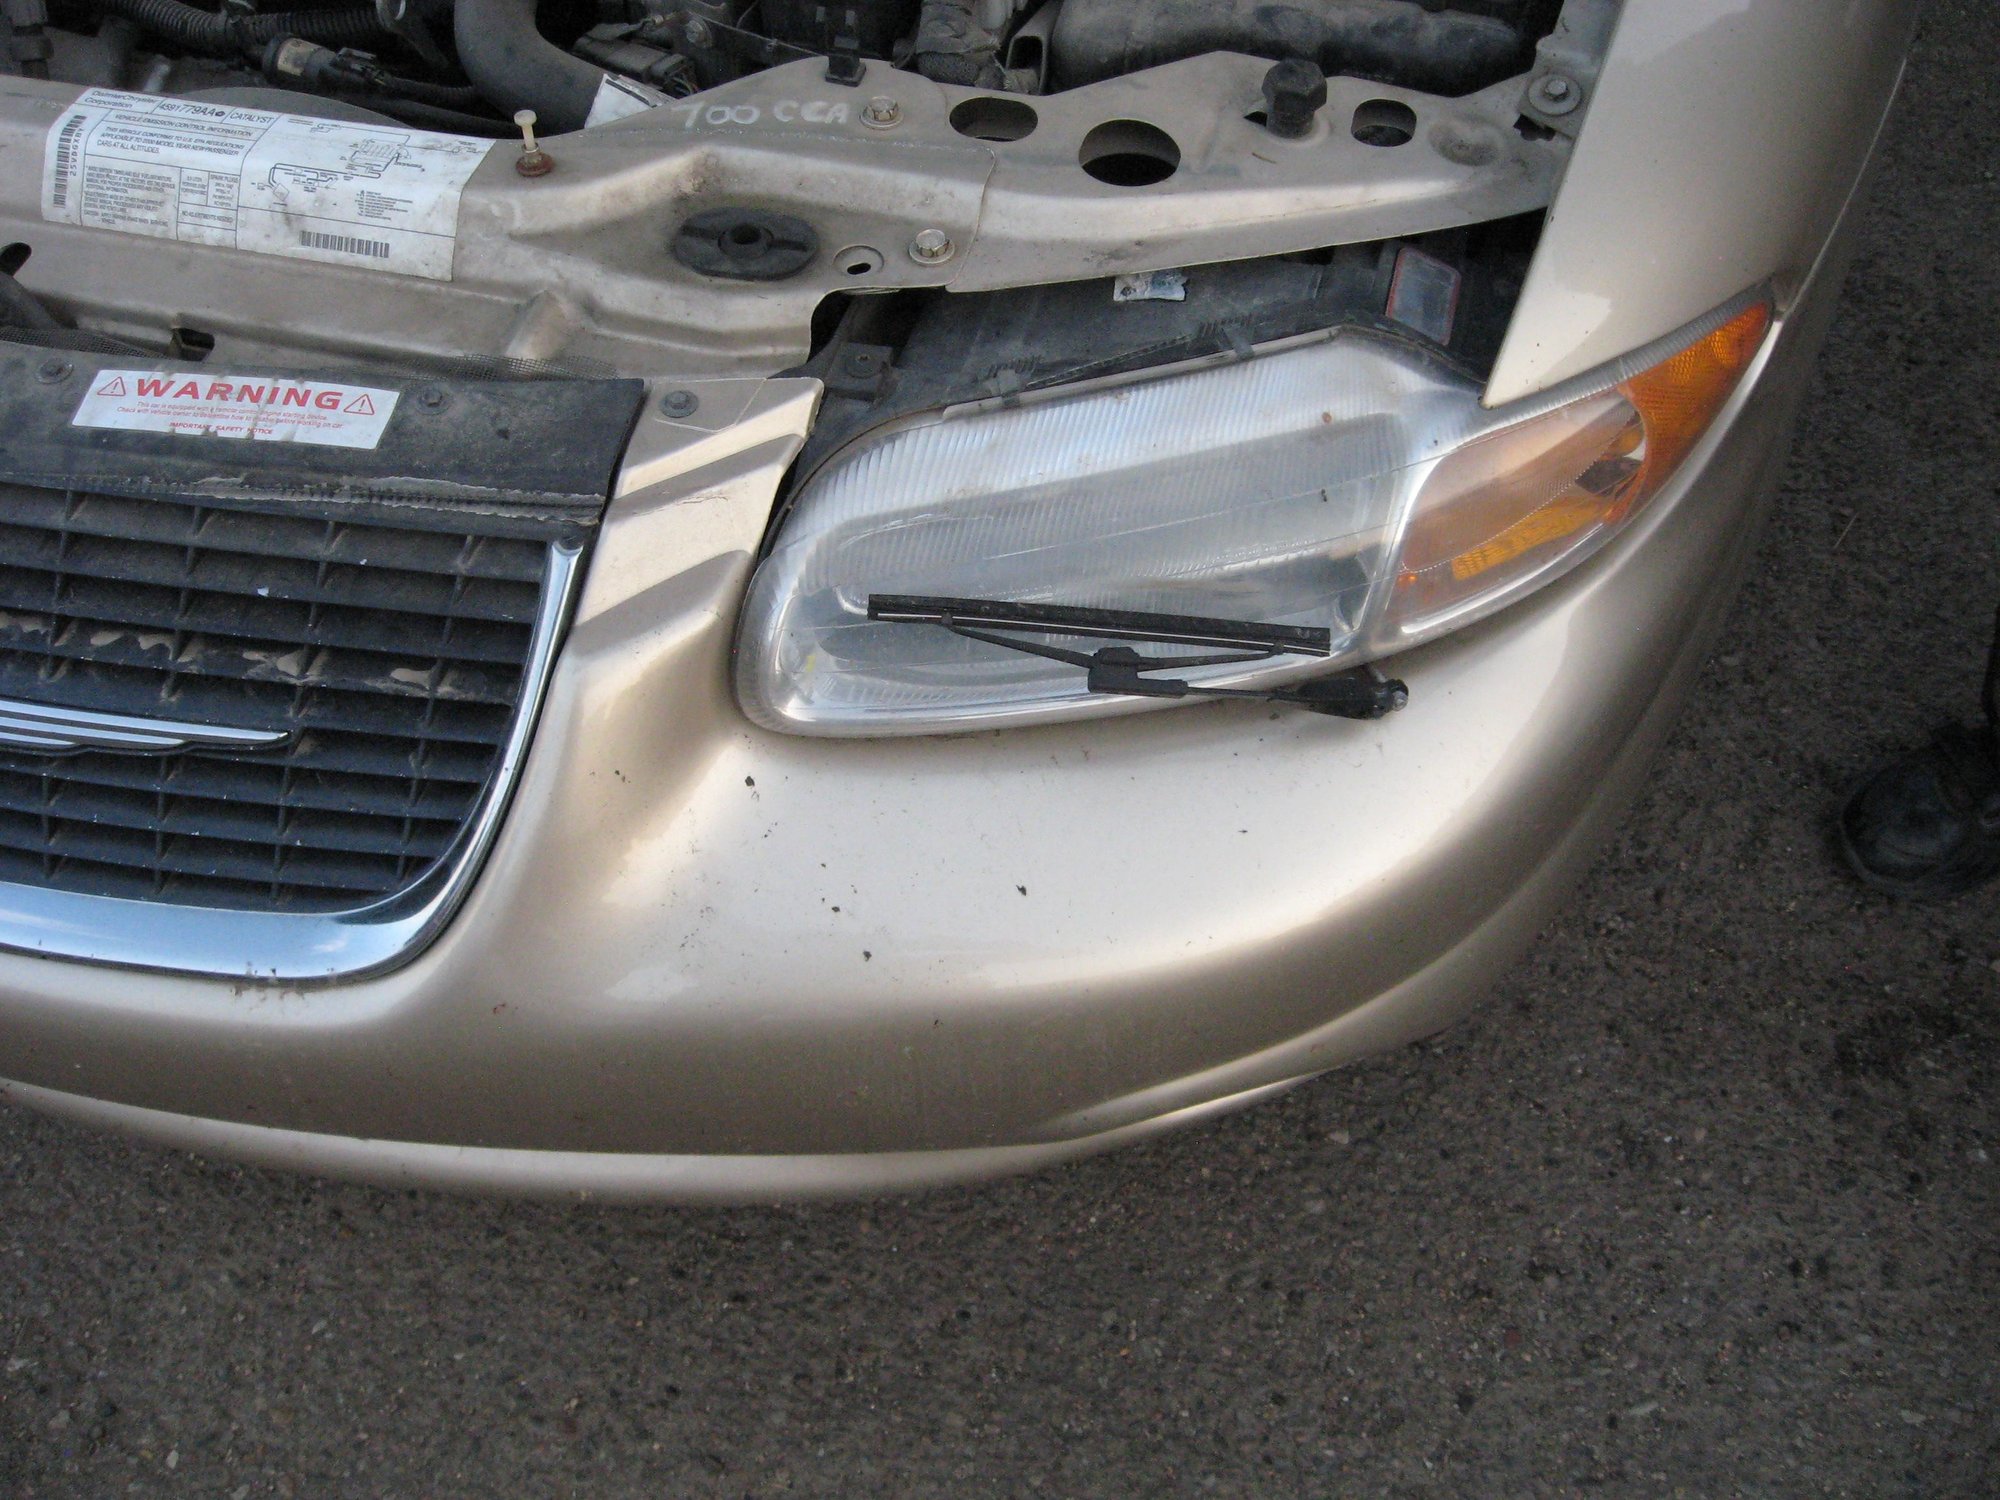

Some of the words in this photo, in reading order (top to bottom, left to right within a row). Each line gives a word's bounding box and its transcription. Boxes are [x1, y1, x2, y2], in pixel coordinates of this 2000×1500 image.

[84, 97, 133, 109] Corporation
[230, 112, 274, 125] CATALYST
[670, 101, 760, 128] 700
[772, 100, 850, 125] CCA
[115, 113, 141, 123] VEHICLE
[175, 121, 206, 132] CONTROL
[206, 126, 253, 138] INFORMATION
[137, 378, 344, 411] WARNING
[169, 422, 212, 430] IMPORTANT
[215, 424, 243, 432] SAFETY
[247, 426, 274, 435] NOTICE
